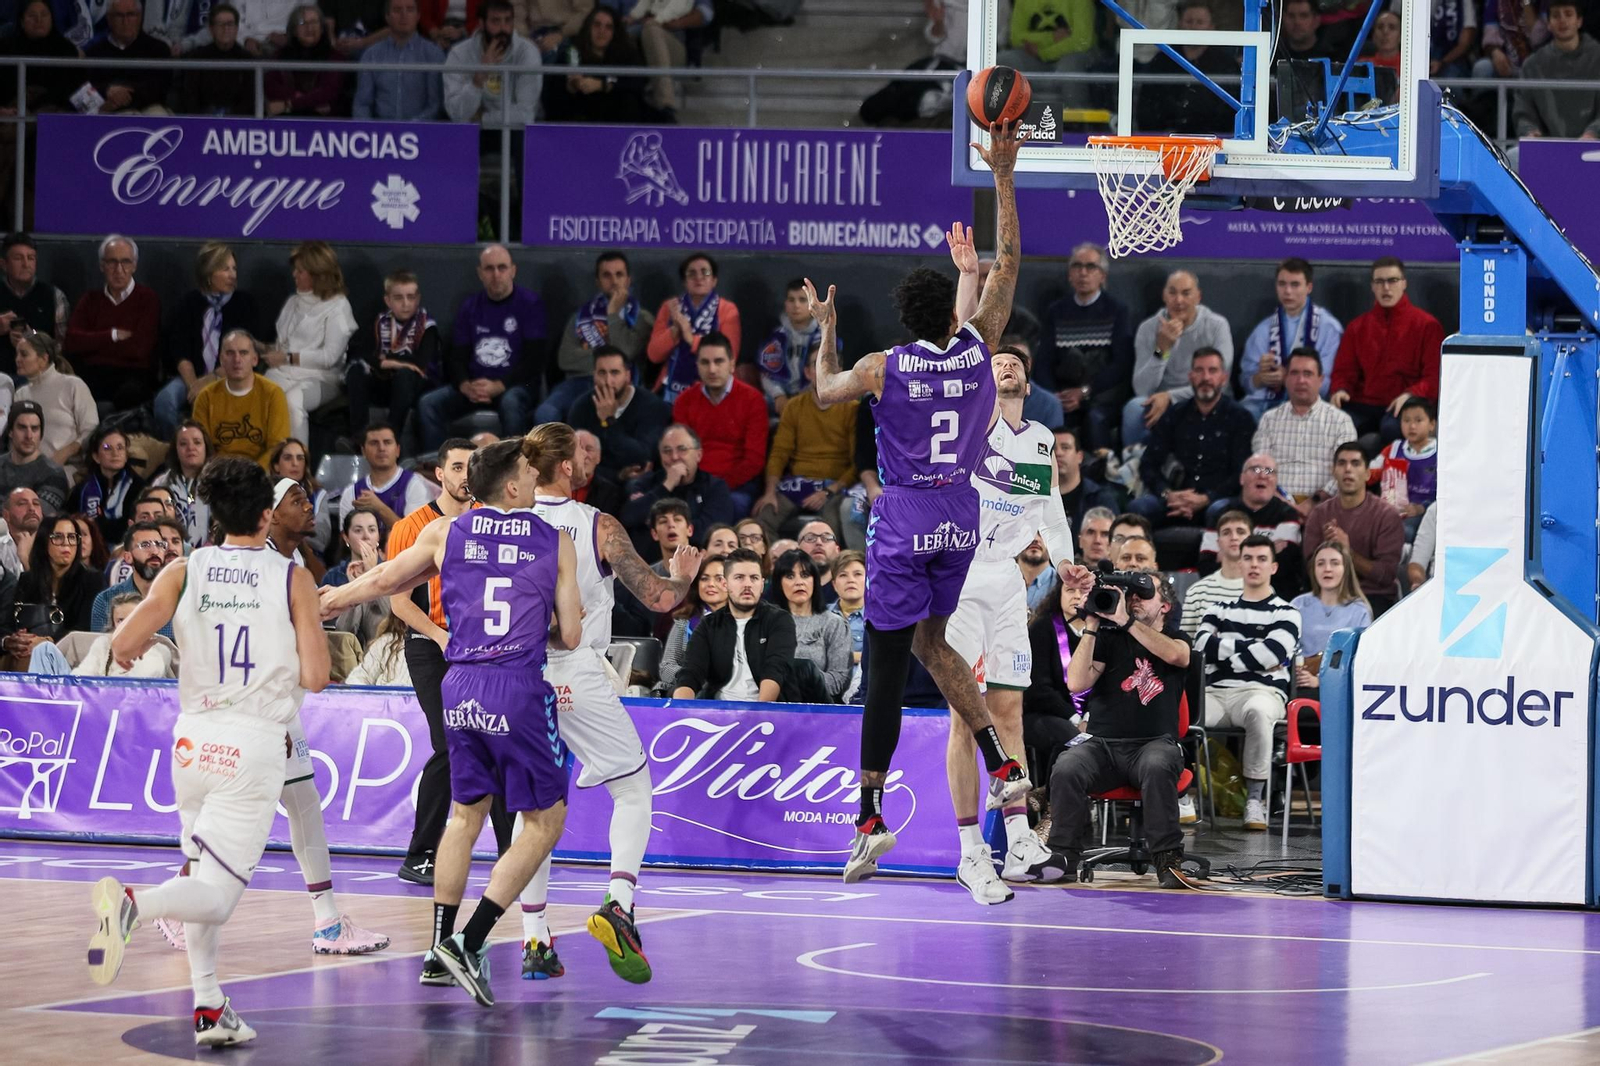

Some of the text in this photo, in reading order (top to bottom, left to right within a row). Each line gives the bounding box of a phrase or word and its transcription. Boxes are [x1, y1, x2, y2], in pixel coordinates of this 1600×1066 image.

[202, 128, 419, 161] AMBULANCIAS
[94, 125, 346, 237] Enrique
[549, 216, 921, 248] FISIOTERAPIA OSTEOPATÍA BIOMECÁNICAS
[1260, 223, 1285, 233] VIVE
[1286, 223, 1294, 233] Y
[1297, 223, 1344, 234] SABOREA
[1346, 224, 1398, 235] NUESTRO
[1400, 225, 1450, 236] ENTORN
[1483, 259, 1496, 323] MONDO
[898, 344, 985, 373] WHITTINGTON
[929, 410, 959, 464] 2
[1009, 472, 1041, 490] Unicaja
[471, 515, 532, 537] ORTEGA
[986, 524, 1000, 549] 4
[913, 529, 977, 551] LEBANZA
[519, 551, 536, 562] Dip
[484, 577, 512, 636] 5
[214, 623, 256, 686] 14
[1361, 675, 1574, 727] zunder
[443, 708, 510, 733] LEBANZA
[199, 754, 238, 769] DEL SOL
[201, 742, 241, 759] COSTA
[784, 811, 860, 825] MODA HOM
